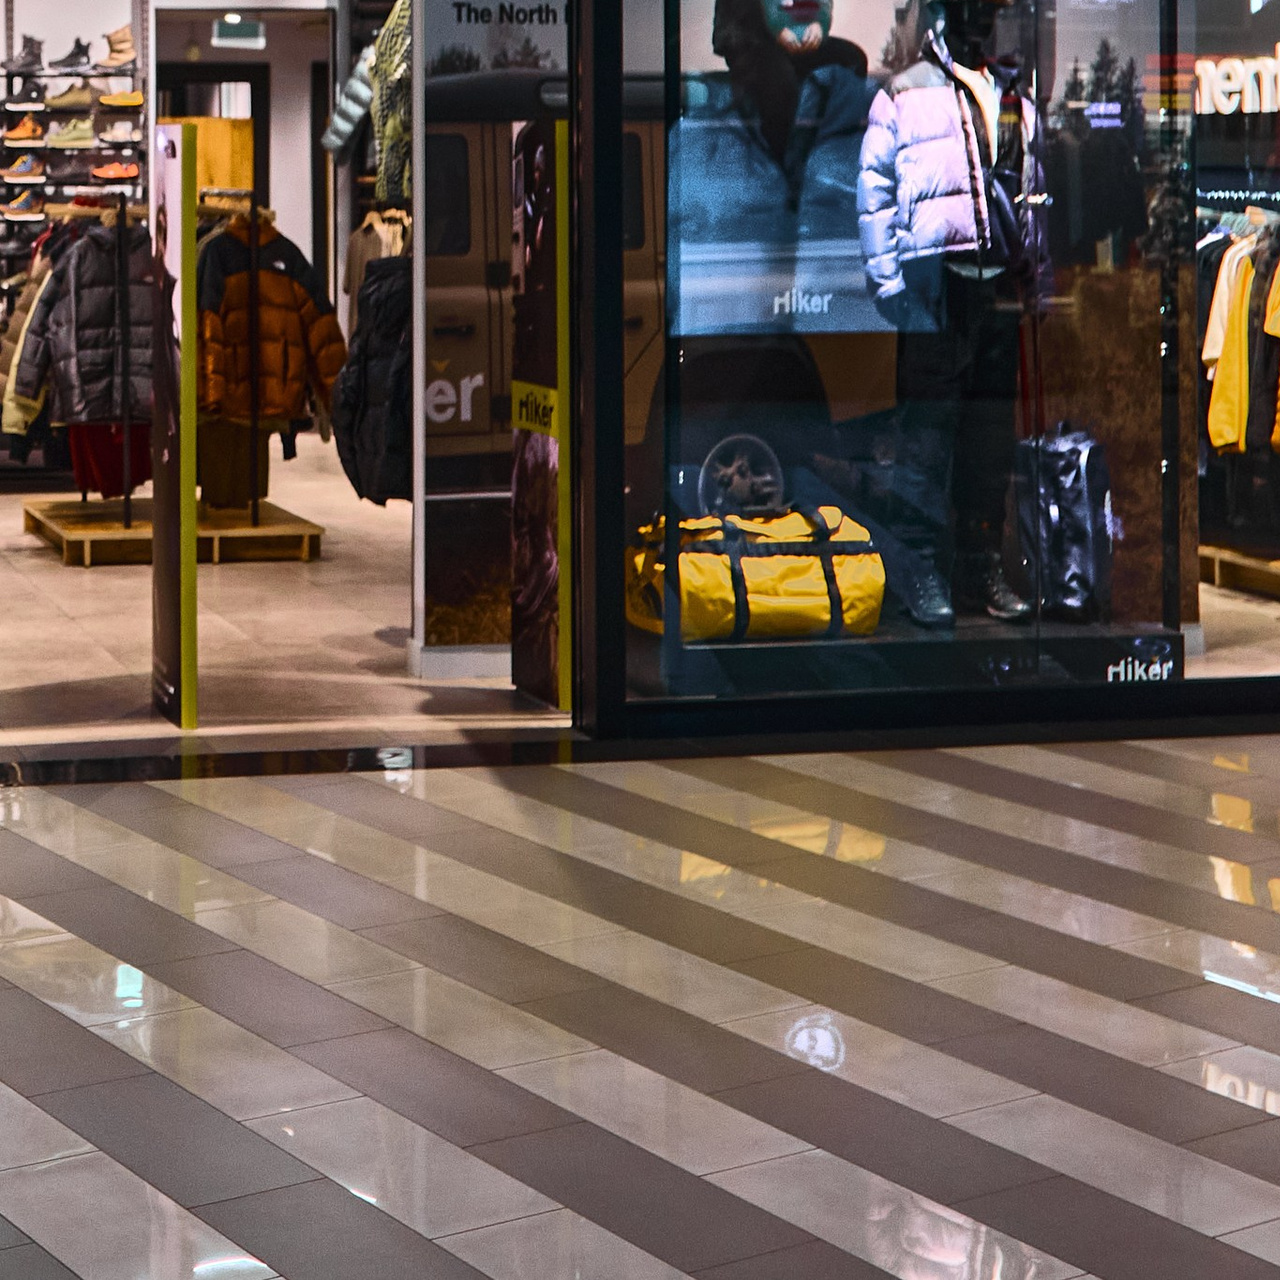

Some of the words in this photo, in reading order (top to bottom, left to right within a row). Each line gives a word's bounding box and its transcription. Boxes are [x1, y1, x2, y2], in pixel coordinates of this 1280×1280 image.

[452, 2, 492, 24] The
[498, 2, 558, 25] North
[773, 287, 833, 314] Hiker
[1107, 656, 1174, 682] Hiker
